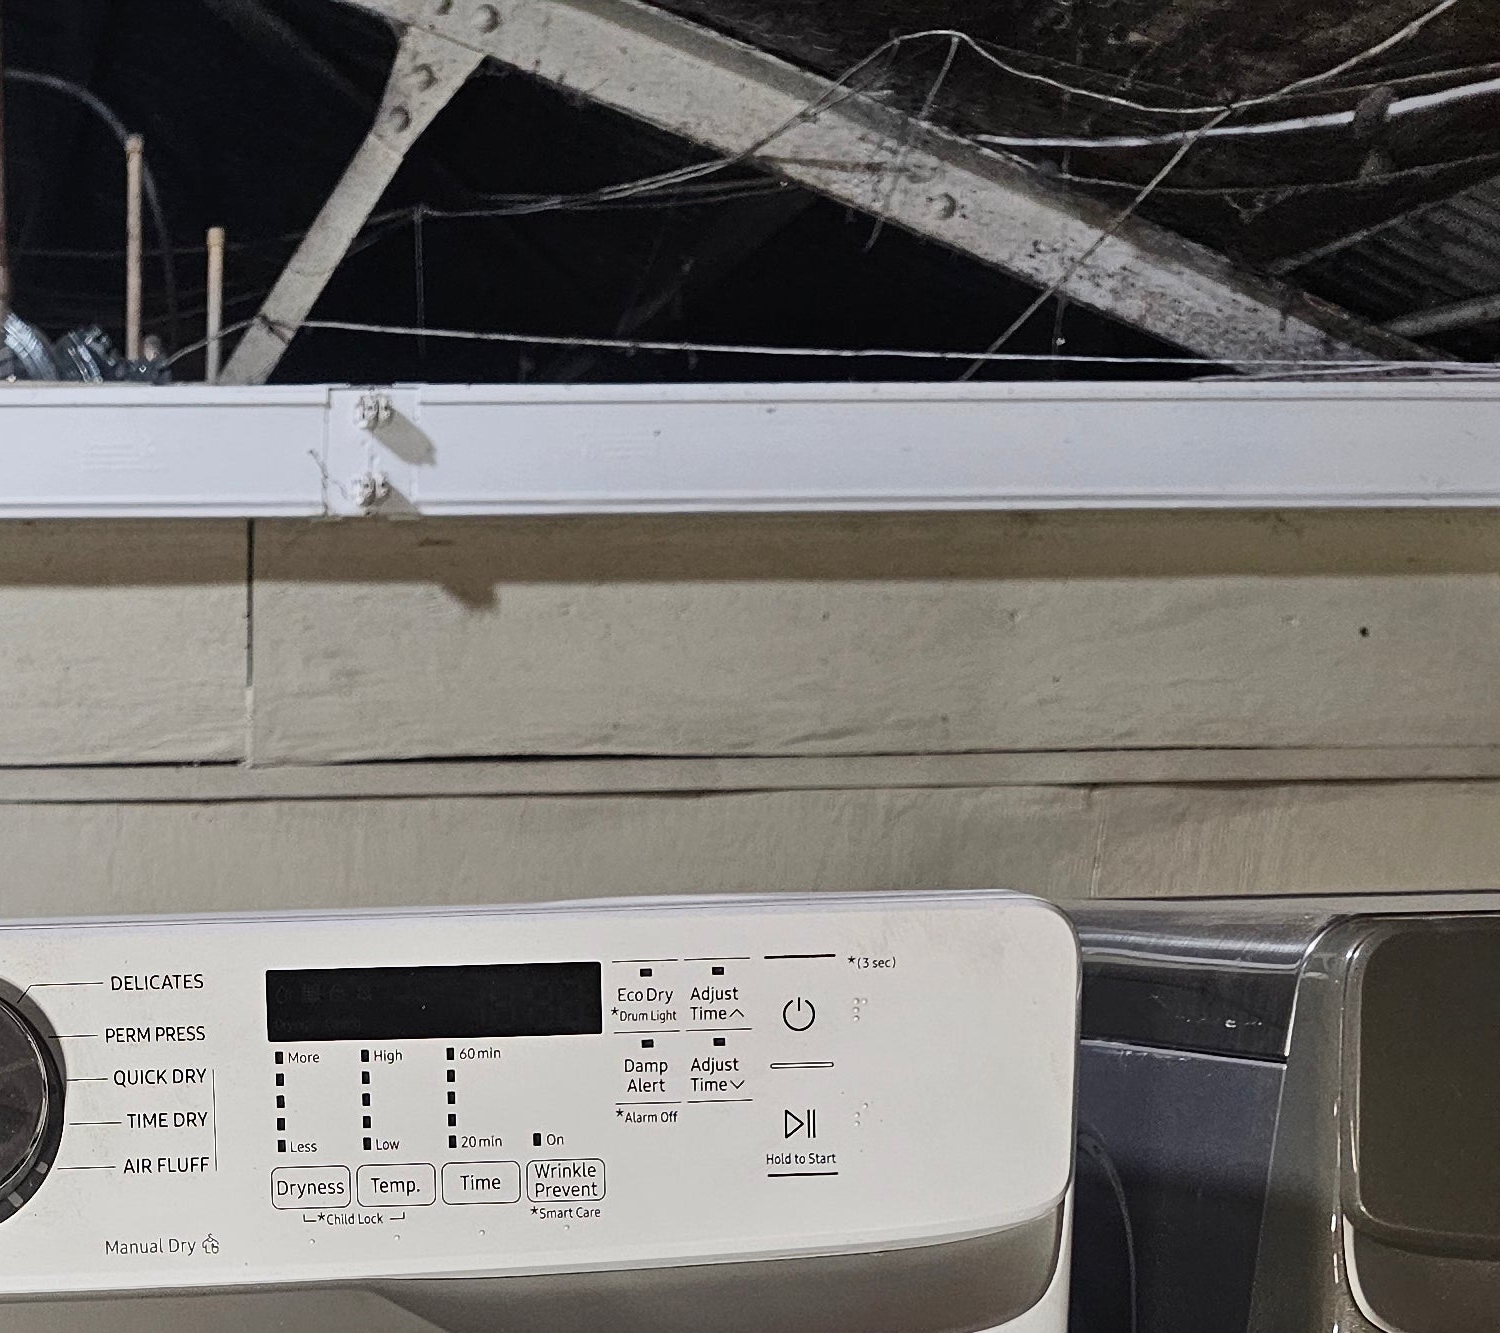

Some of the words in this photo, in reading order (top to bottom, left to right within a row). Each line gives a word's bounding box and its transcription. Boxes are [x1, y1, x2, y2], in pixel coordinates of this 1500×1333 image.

[872, 956, 897, 969] sec)
[110, 974, 205, 991] DELICATES
[617, 988, 644, 1002] Eco
[646, 987, 674, 1004] Dry
[690, 986, 739, 1004] Adjust
[650, 1009, 677, 1023] Light
[690, 1006, 727, 1021] Time
[105, 1027, 151, 1044] PERM
[155, 1026, 206, 1042] PRESS
[287, 1052, 320, 1064] More
[373, 1050, 403, 1063] High
[458, 1047, 476, 1060] 60
[477, 1047, 502, 1060] min
[623, 1058, 669, 1075] Damp
[690, 1057, 740, 1075] Adjust
[113, 1069, 168, 1088] QUICK
[172, 1068, 207, 1085] DRY
[627, 1078, 666, 1093] Alert
[690, 1076, 728, 1092] Time
[126, 1113, 169, 1129] TIME
[173, 1112, 208, 1128] DRY
[660, 1110, 679, 1123] Off
[289, 1140, 318, 1153] Less
[375, 1138, 400, 1151] Low
[460, 1135, 478, 1148] 20
[478, 1135, 503, 1148] min
[546, 1134, 565, 1146] On
[123, 1158, 153, 1174] AIR
[156, 1157, 210, 1173] FLUFF
[765, 1153, 792, 1165] Hold
[794, 1153, 806, 1165] to
[807, 1152, 837, 1165] Start
[534, 1162, 597, 1179] Wrinkle
[277, 1179, 345, 1199] Dryness
[370, 1177, 421, 1196] Temp.
[460, 1174, 502, 1190] Time
[534, 1182, 598, 1198] Prevent
[358, 1213, 384, 1225] Lock
[576, 1206, 602, 1219] Care
[105, 1238, 164, 1256] Manual
[168, 1239, 197, 1257] Dry
